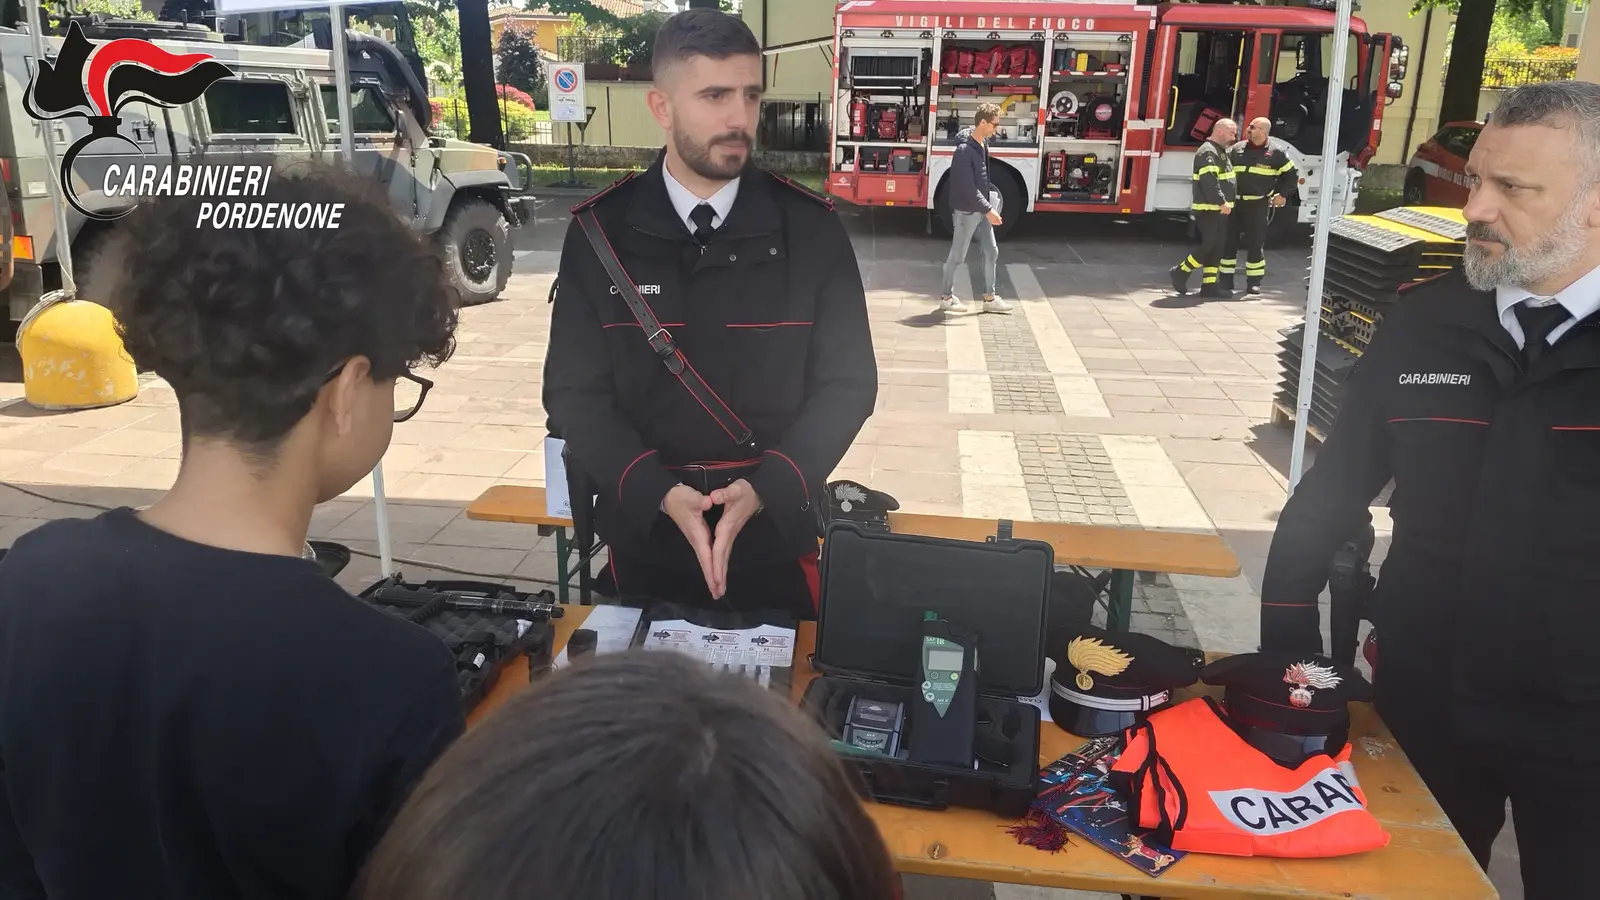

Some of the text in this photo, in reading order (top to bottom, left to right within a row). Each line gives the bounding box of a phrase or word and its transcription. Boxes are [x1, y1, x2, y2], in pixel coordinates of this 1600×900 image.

[895, 15, 1095, 30] VIGILI DEL FUOCO
[609, 284, 661, 295] CNIERI
[1398, 373, 1471, 386] CARABINIERI
